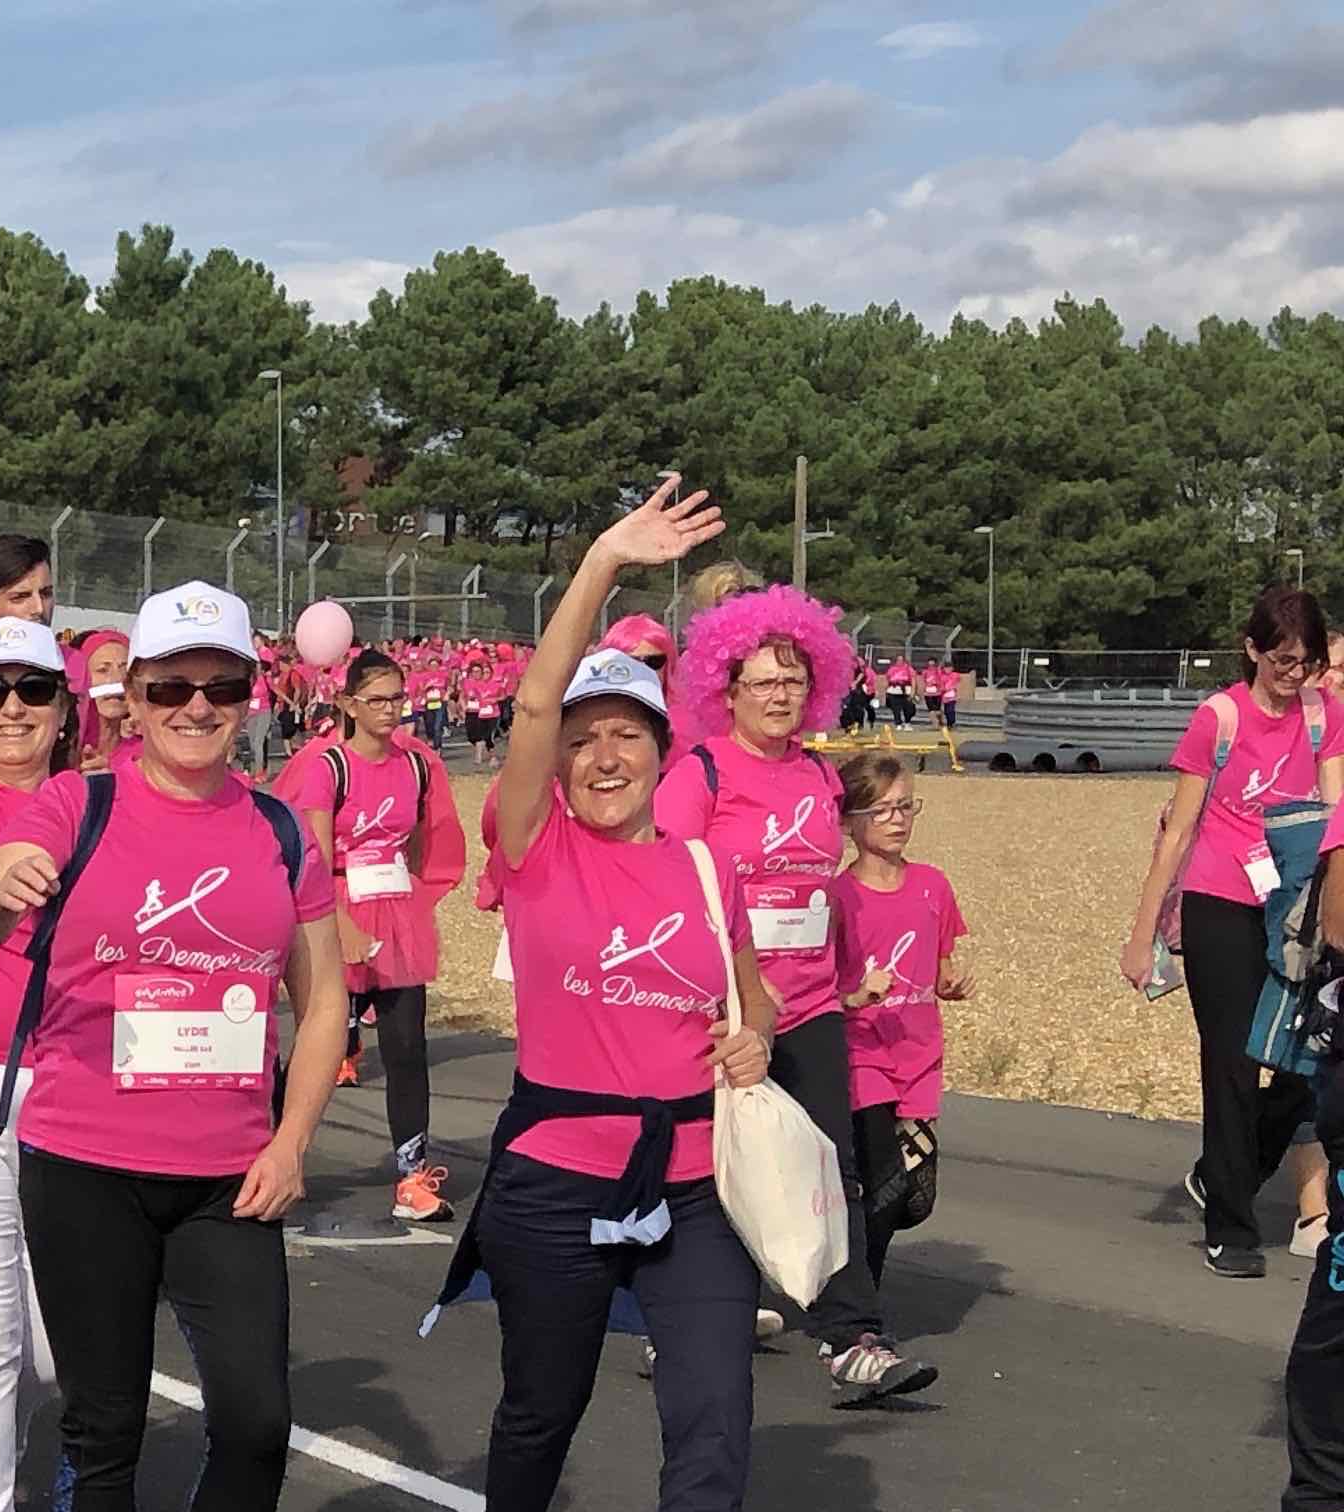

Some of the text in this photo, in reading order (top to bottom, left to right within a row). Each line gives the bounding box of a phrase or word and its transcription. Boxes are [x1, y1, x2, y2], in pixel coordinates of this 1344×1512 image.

[95, 933, 128, 964] les
[562, 965, 594, 997] les
[176, 1025, 210, 1038] LYDIE
